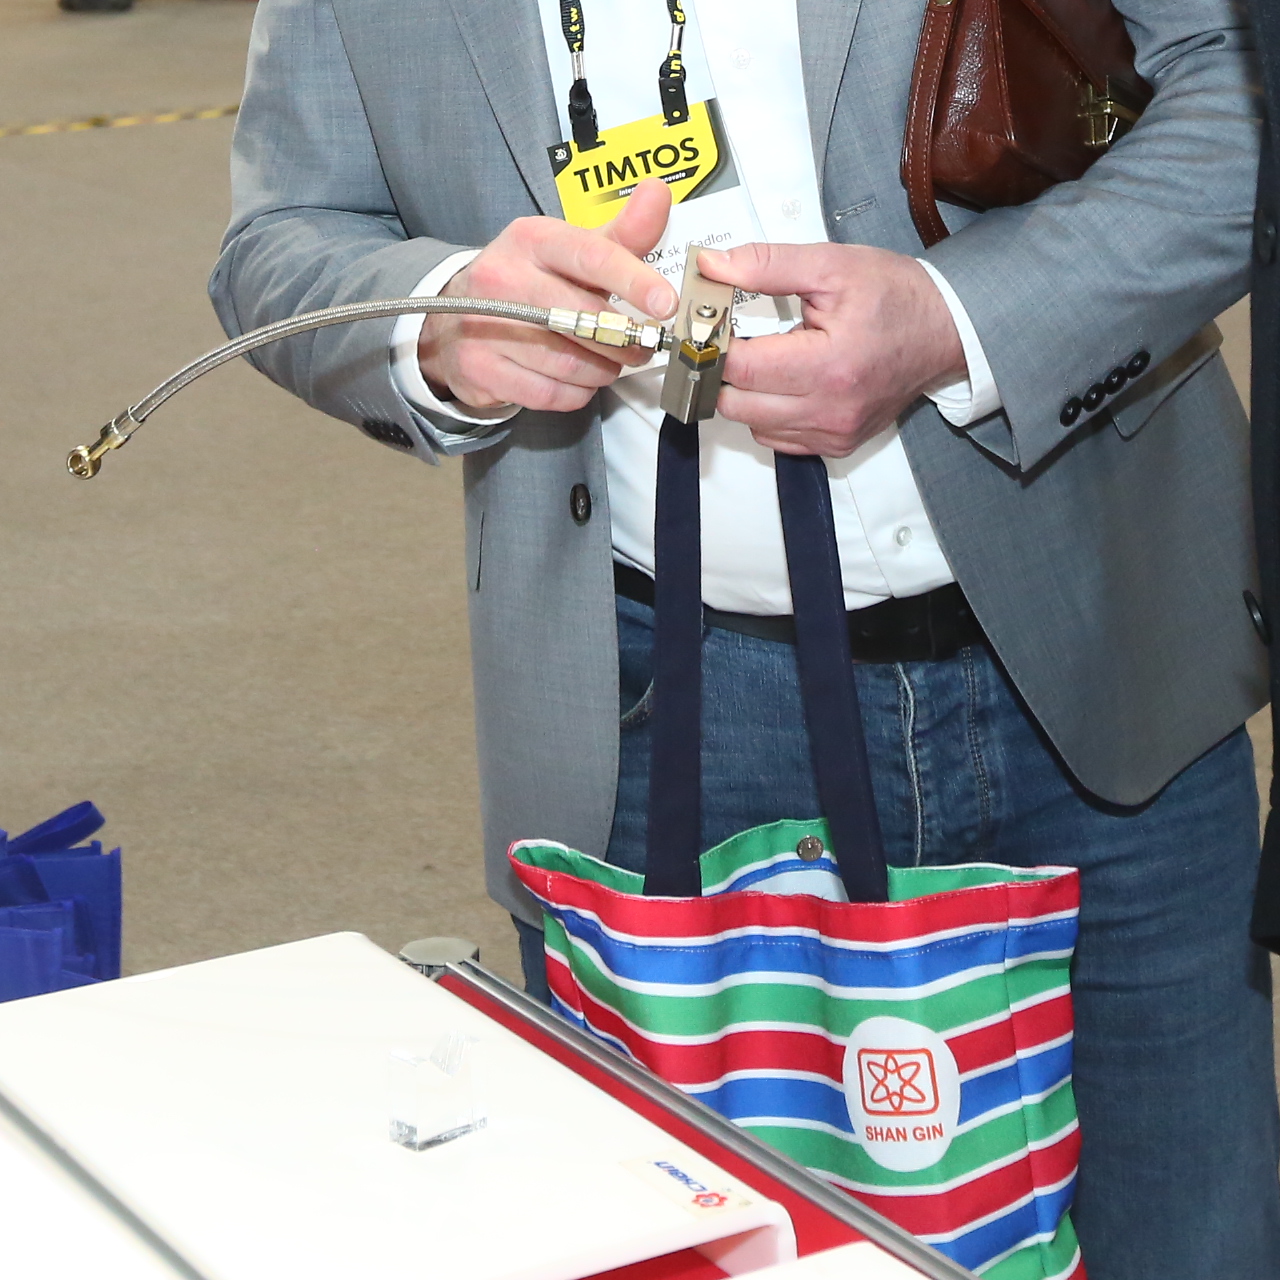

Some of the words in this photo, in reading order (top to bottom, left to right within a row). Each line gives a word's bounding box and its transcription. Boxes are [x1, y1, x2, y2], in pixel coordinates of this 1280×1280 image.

[574, 136, 700, 193] TIMTOS
[865, 1125, 908, 1142] SHAN
[912, 1123, 944, 1142] GIN
